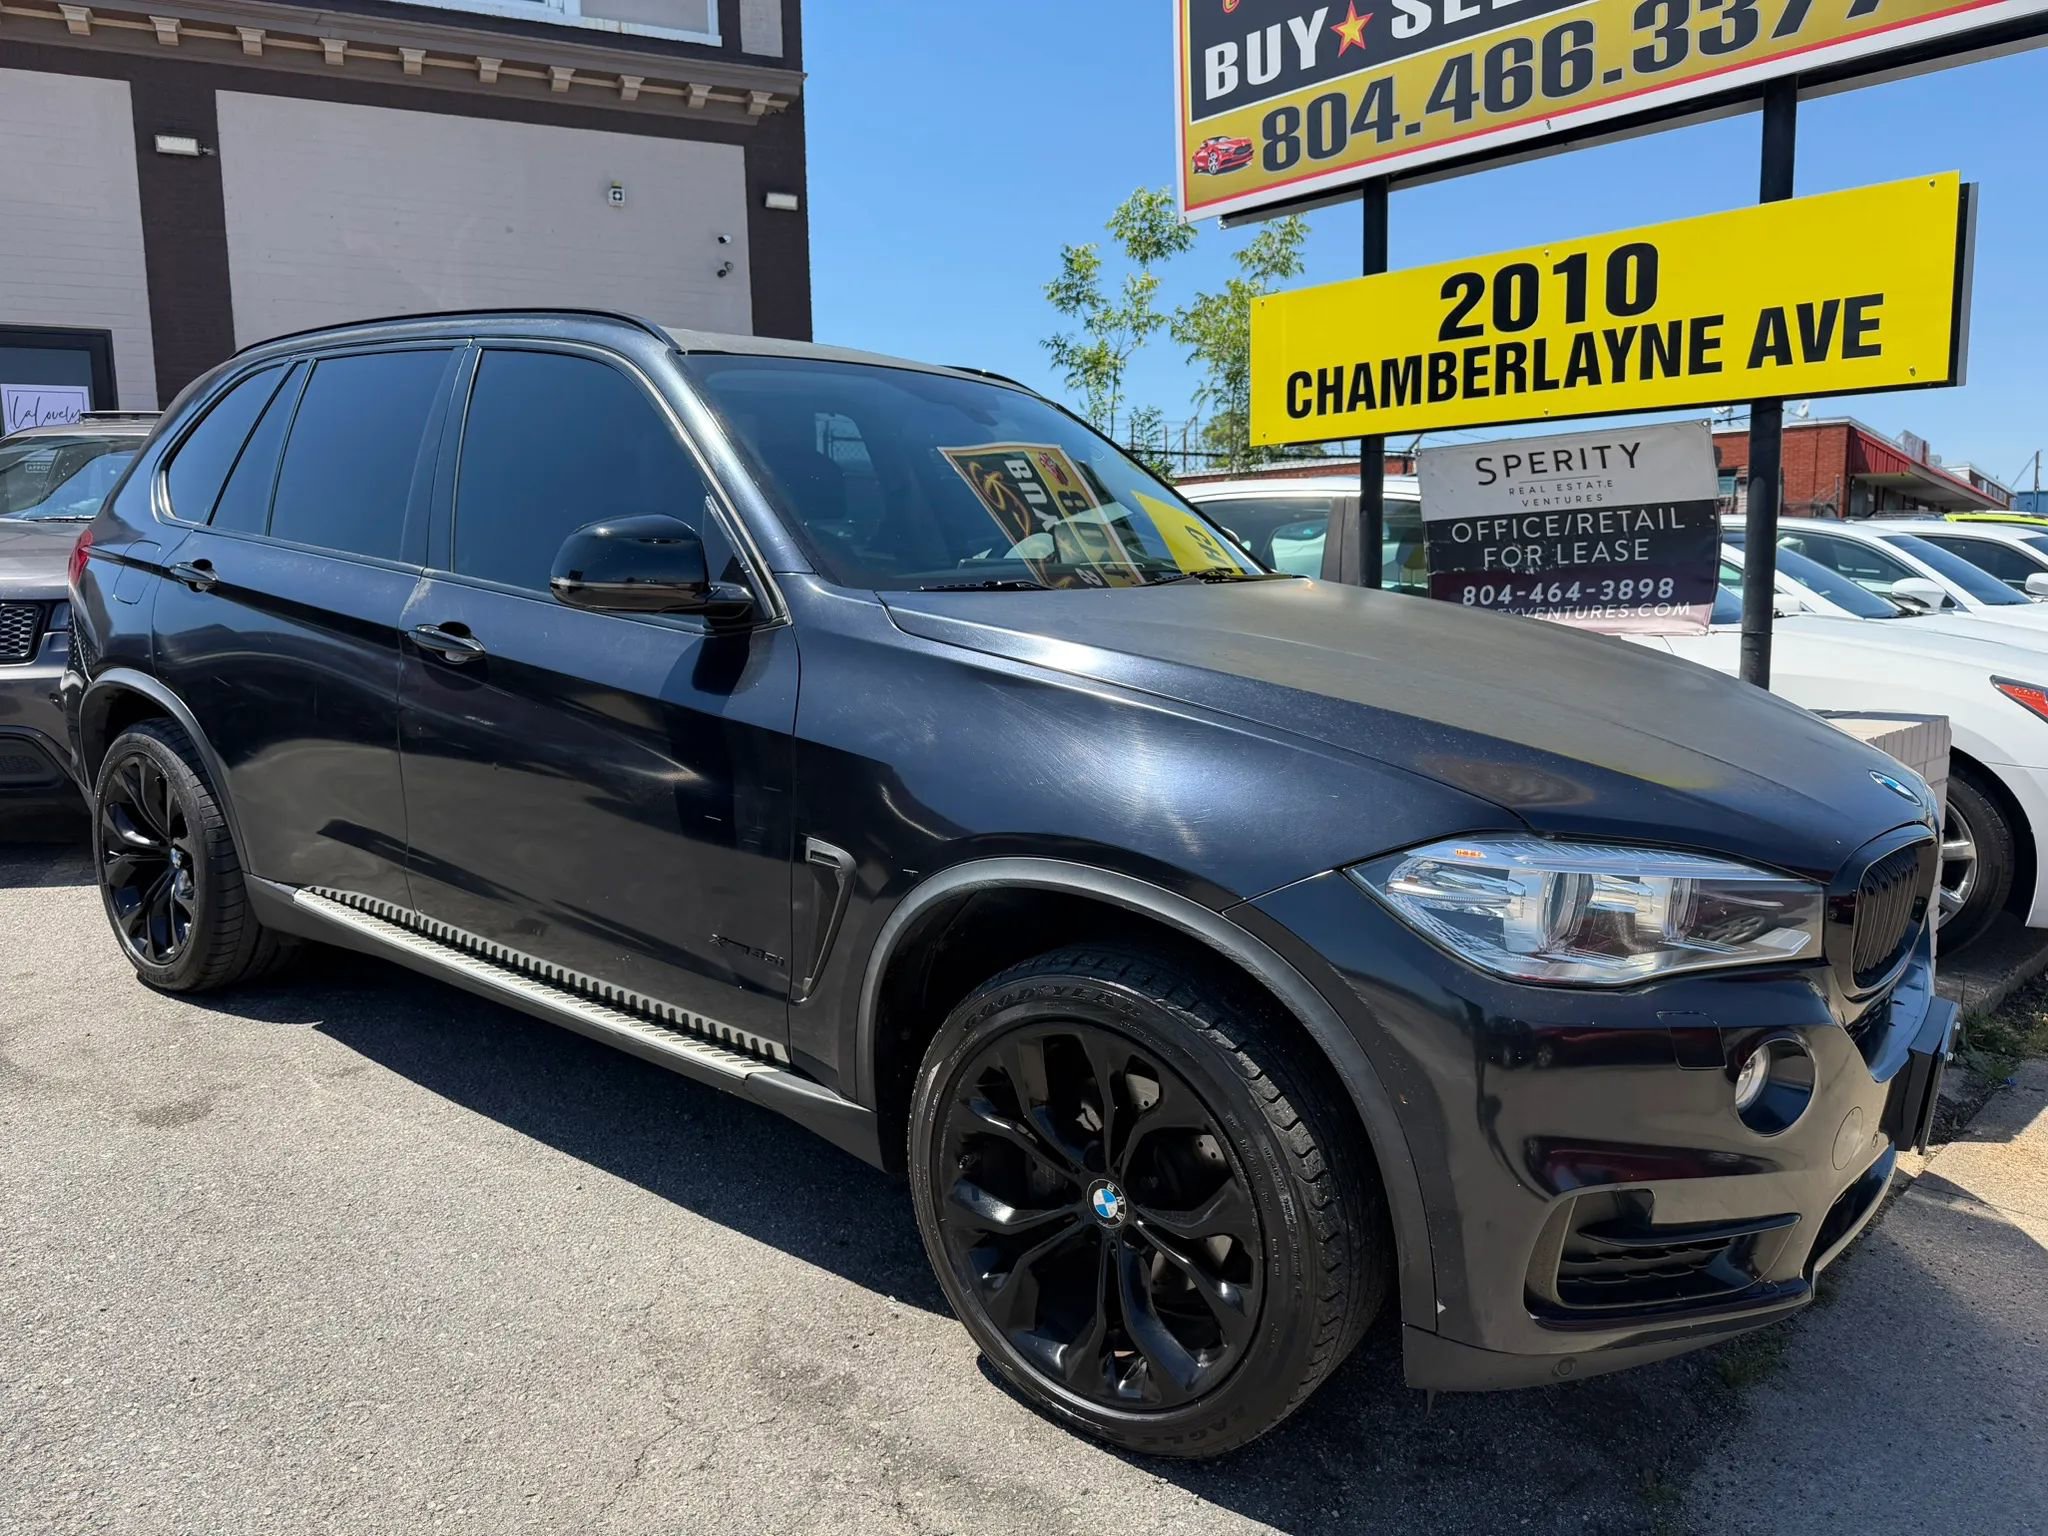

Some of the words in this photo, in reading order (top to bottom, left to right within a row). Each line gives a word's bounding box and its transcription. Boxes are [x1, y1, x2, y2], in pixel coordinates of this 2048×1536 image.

[1205, 6, 1329, 101] BUY
[1438, 242, 1659, 341] 2010
[1285, 314, 1725, 420] CHAMBERLAYNE
[1746, 293, 1885, 369] AVE
[1475, 442, 1641, 486] SPERITY
[1509, 485, 1546, 496] REAL
[1556, 479, 1615, 492] ESTATE
[1521, 493, 1603, 507] VENTURES
[1451, 507, 1686, 544] OFFICE/RETAIL
[1484, 546, 1542, 568] FOR
[1557, 538, 1650, 565] LEASE
[1463, 577, 1675, 606] 804-464-3898
